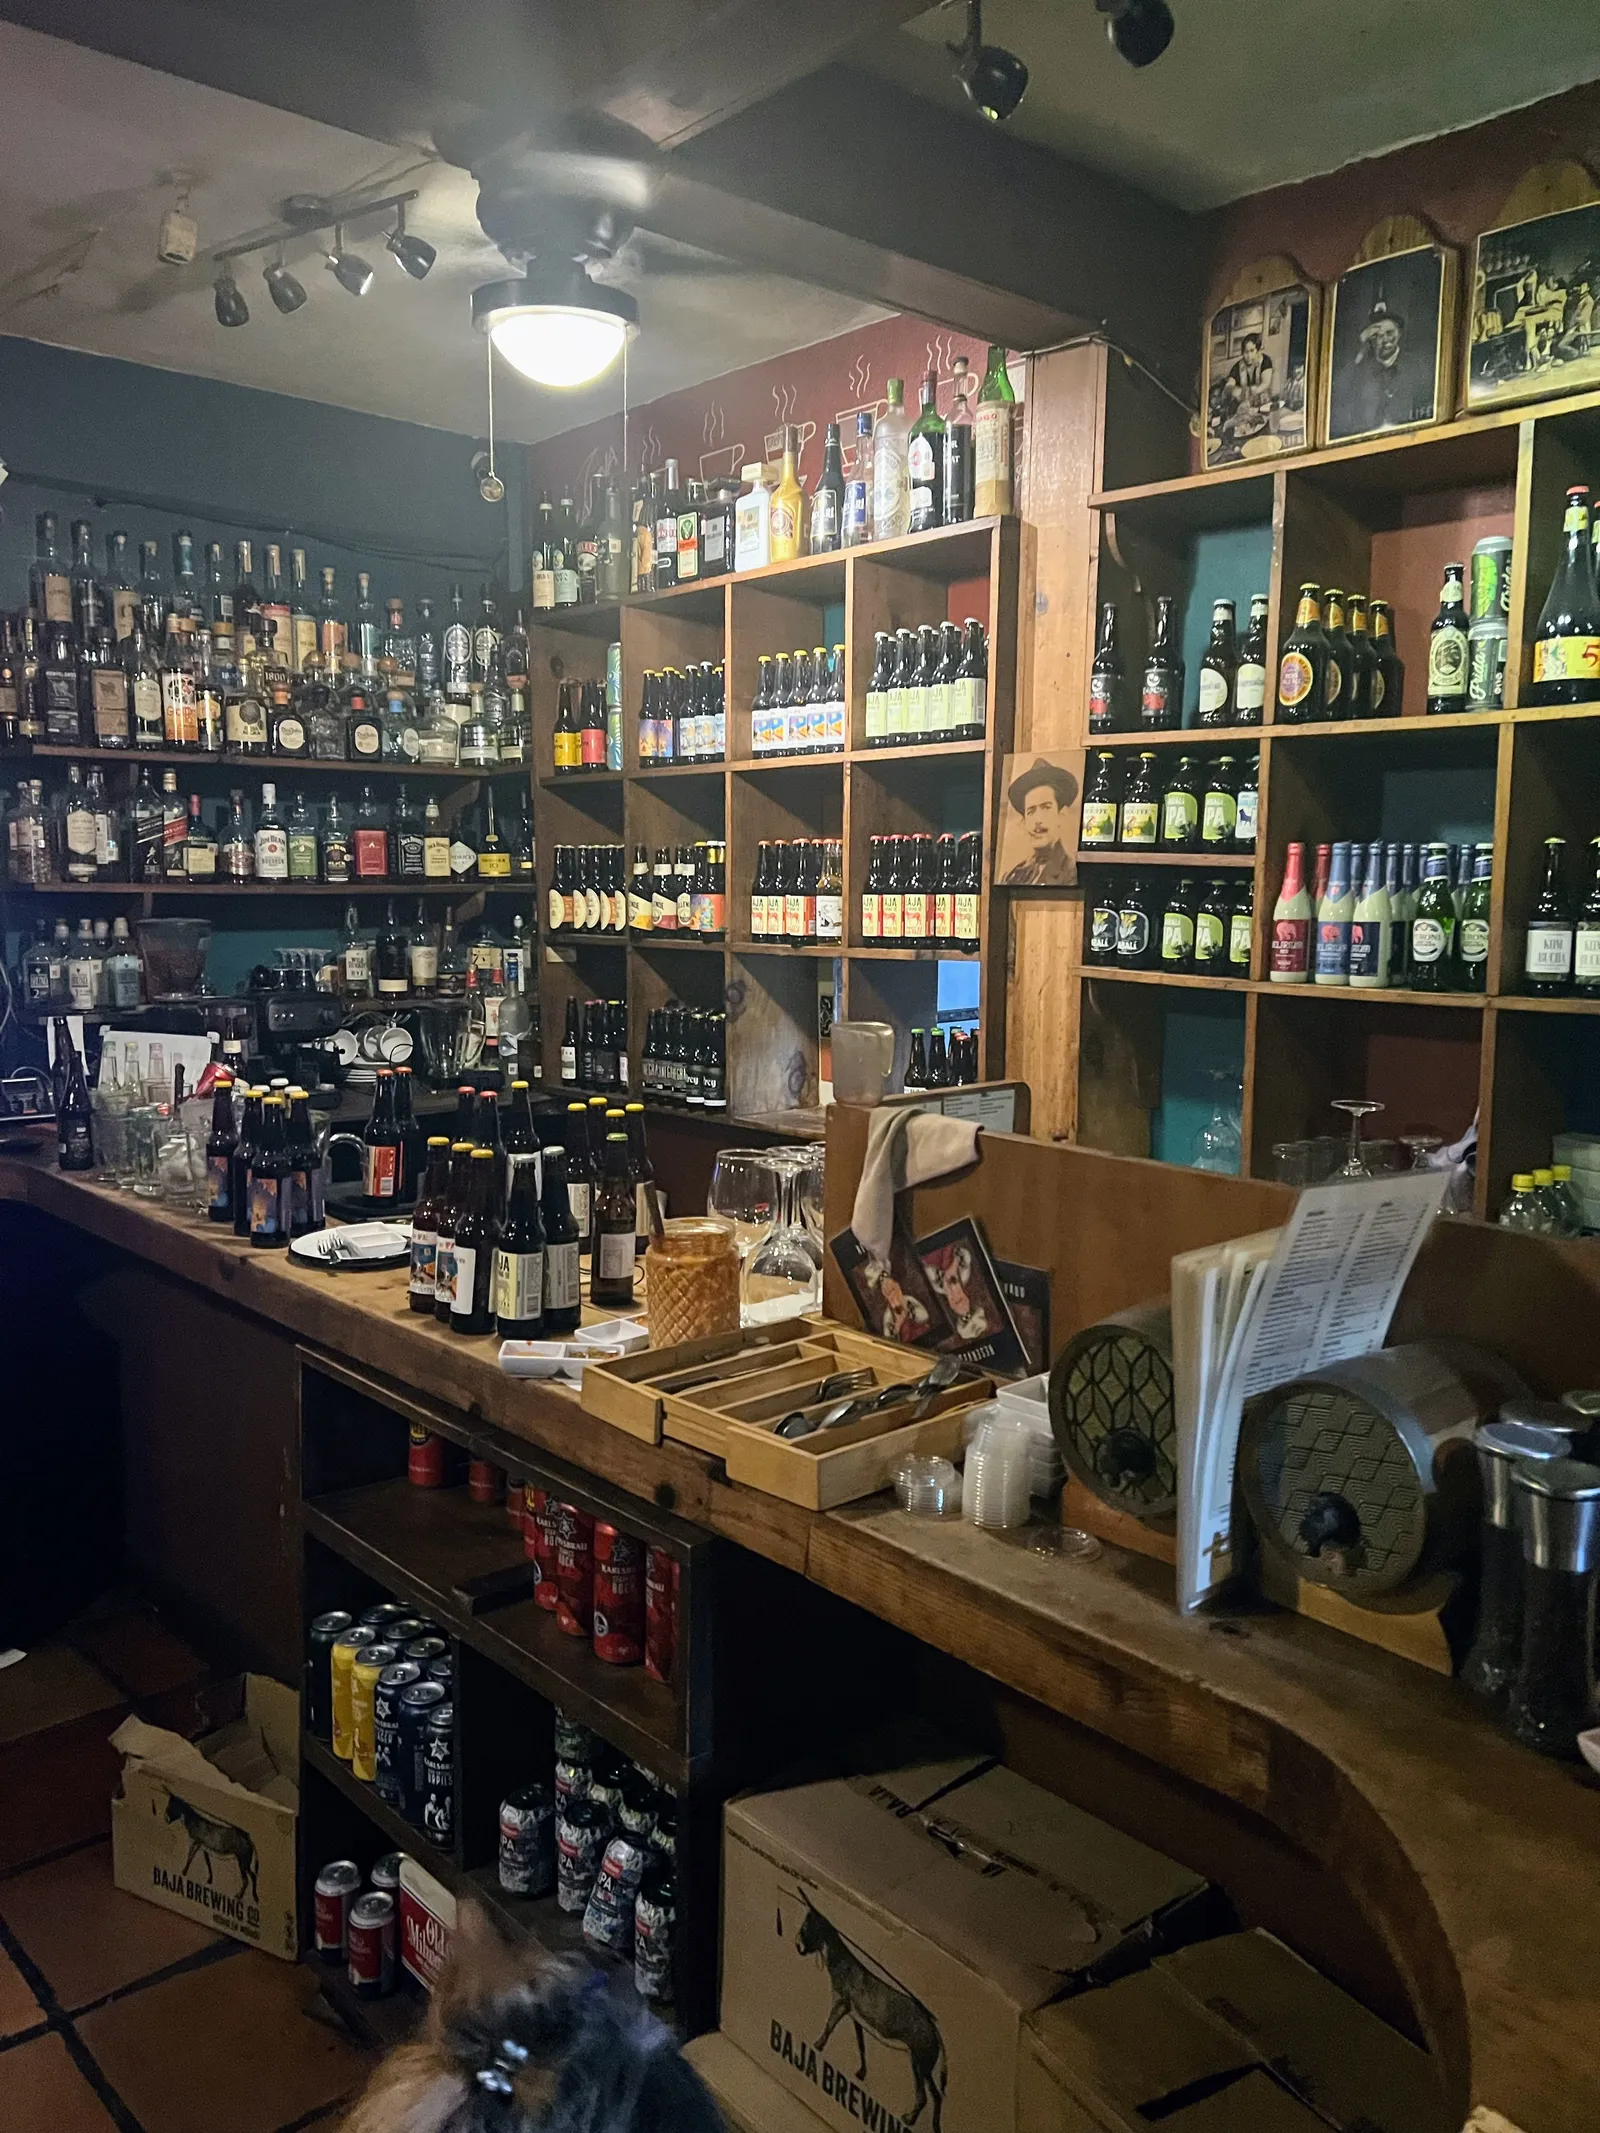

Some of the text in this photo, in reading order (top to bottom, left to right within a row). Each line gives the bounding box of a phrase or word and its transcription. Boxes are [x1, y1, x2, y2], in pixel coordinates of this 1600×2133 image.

[1409, 406, 1433, 420] LIFE
[1282, 434, 1304, 446] LIFE
[153, 1866, 185, 1898] BAJA
[186, 1879, 245, 1922] BREWING
[770, 2018, 818, 2086] BAJA
